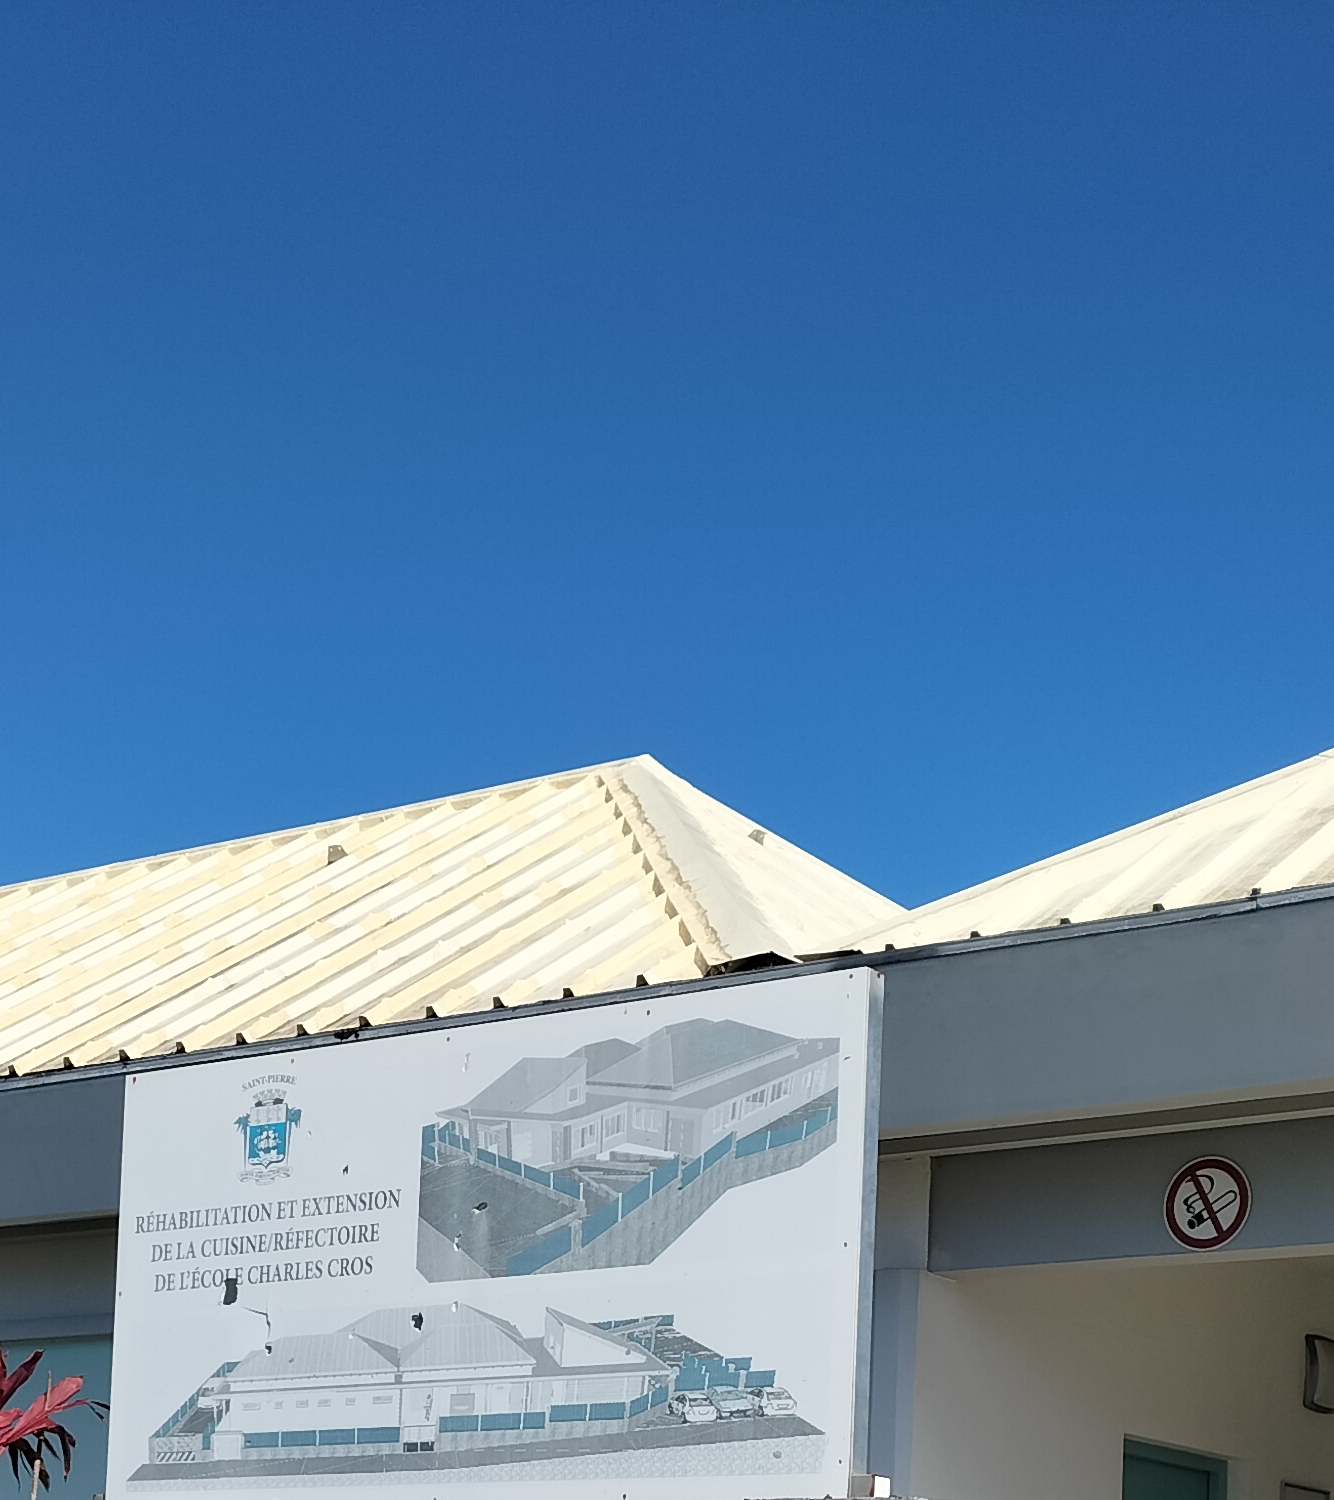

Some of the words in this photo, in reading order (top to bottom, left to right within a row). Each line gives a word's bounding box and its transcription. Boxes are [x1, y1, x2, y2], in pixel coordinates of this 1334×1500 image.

[135, 1203, 273, 1233] RÉHABILITATION
[276, 1200, 298, 1219] ET
[301, 1189, 402, 1217] EXTENSION
[151, 1244, 173, 1262] DE
[175, 1241, 197, 1260] LA
[201, 1223, 380, 1257] CUISINE/RÉFECTOIRE
[154, 1273, 176, 1292] DE
[247, 1259, 322, 1285] CHARLES
[327, 1256, 373, 1277] CROS
